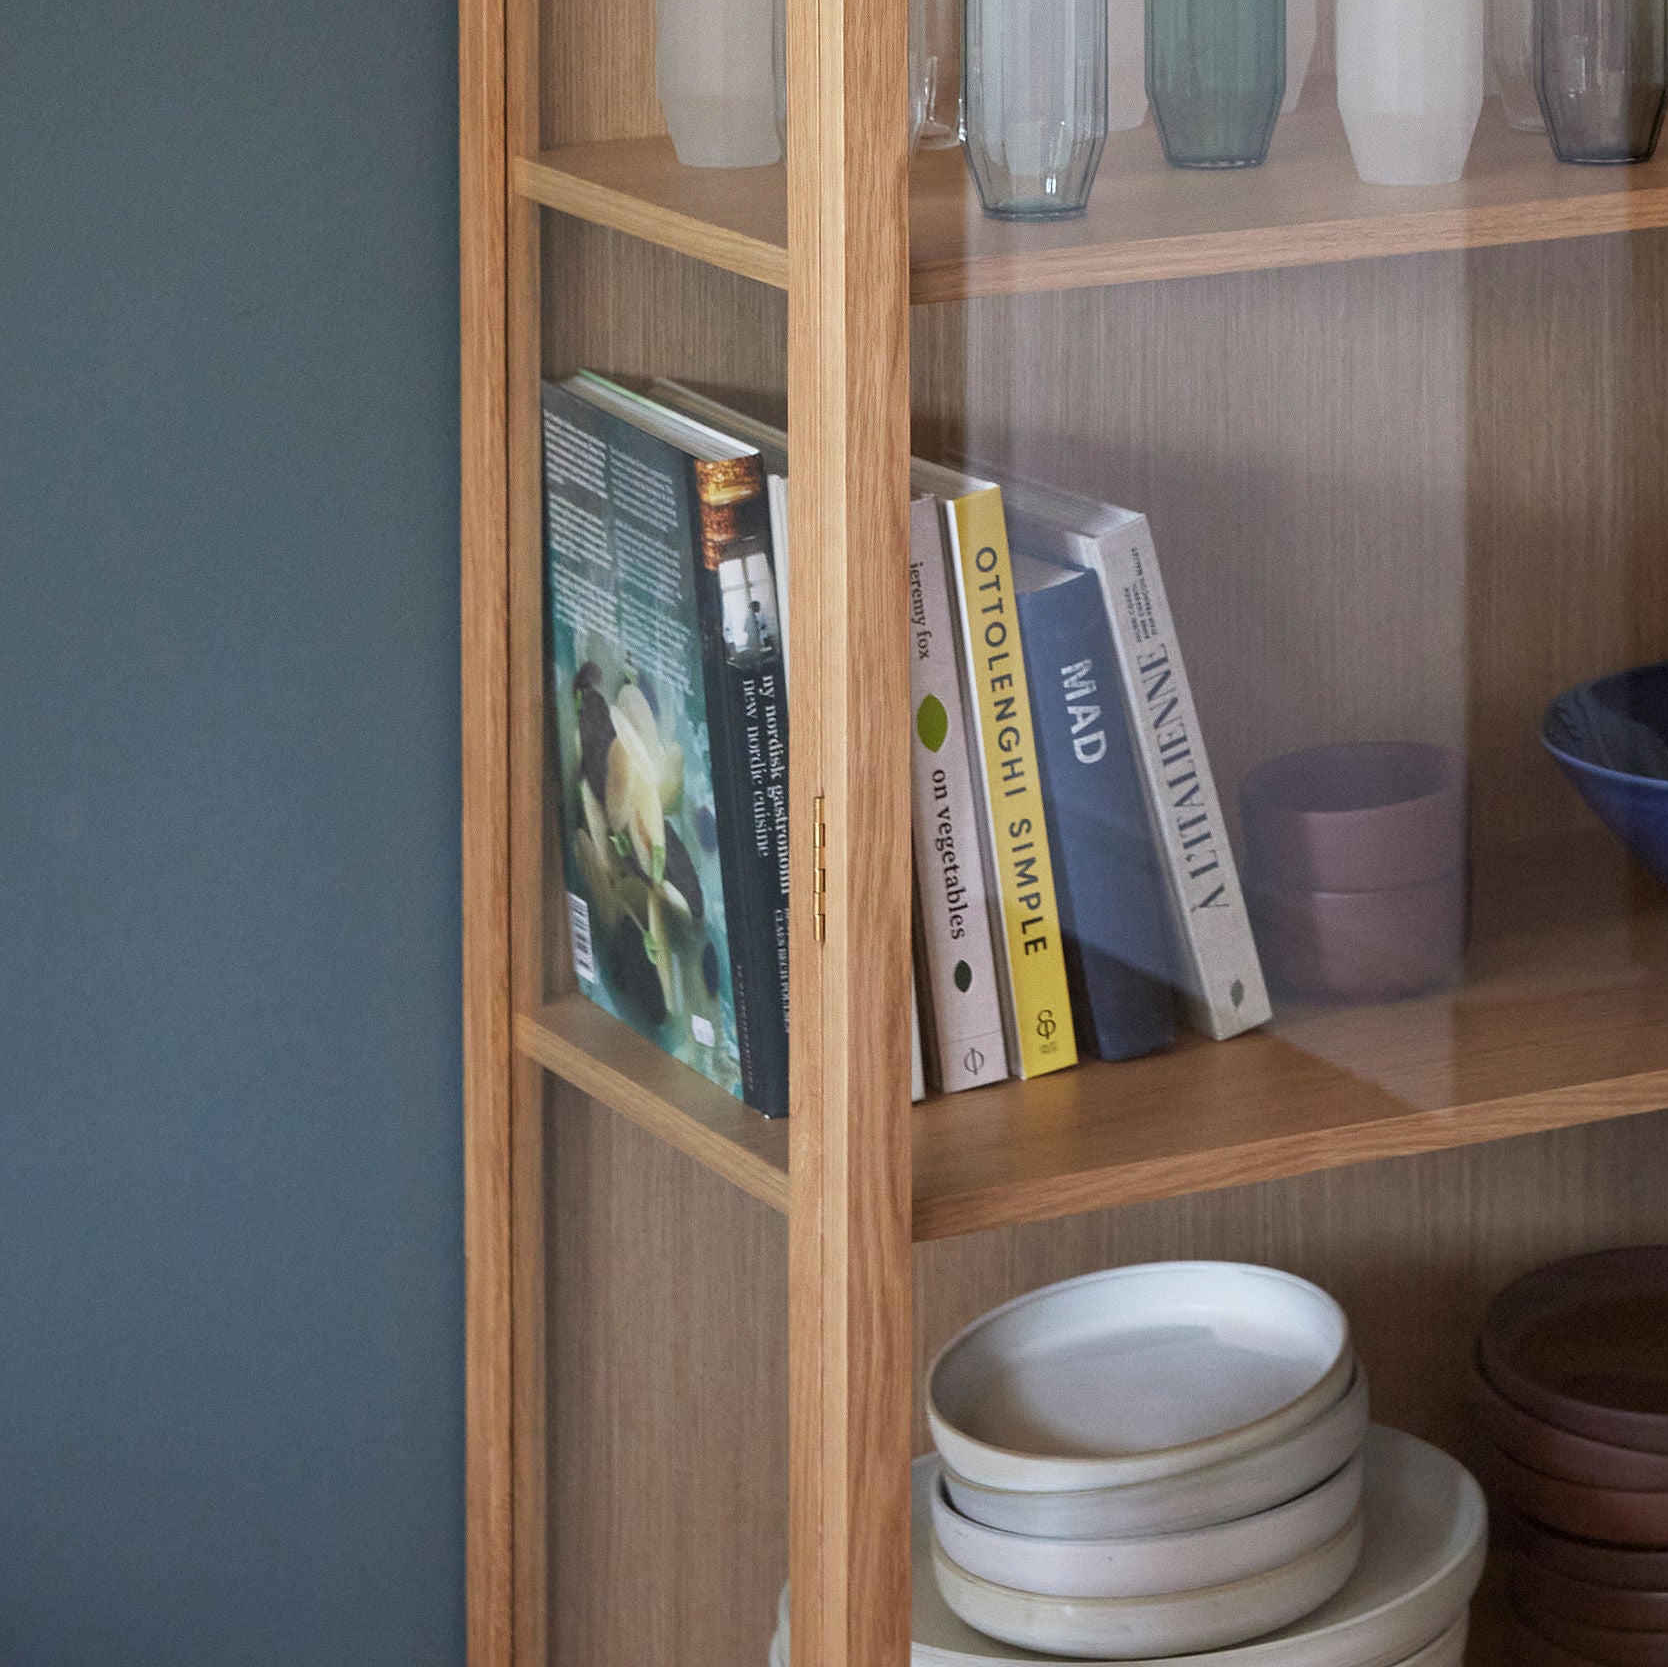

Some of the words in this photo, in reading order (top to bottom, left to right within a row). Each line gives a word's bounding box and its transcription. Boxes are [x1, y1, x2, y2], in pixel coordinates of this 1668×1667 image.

[916, 630, 932, 660] fox
[743, 679, 758, 718] new
[759, 675, 776, 698] ny
[1061, 658, 1107, 764] MAD
[747, 725, 768, 785] nordic
[765, 705, 786, 780] nordisk
[975, 546, 1027, 798] OTTOLENGHI
[1009, 818, 1047, 956] SIMPLE
[1137, 643, 1220, 880] L'ITALIENNE
[931, 769, 948, 801] on
[753, 790, 773, 858] cuisine
[935, 806, 969, 940] vegetables
